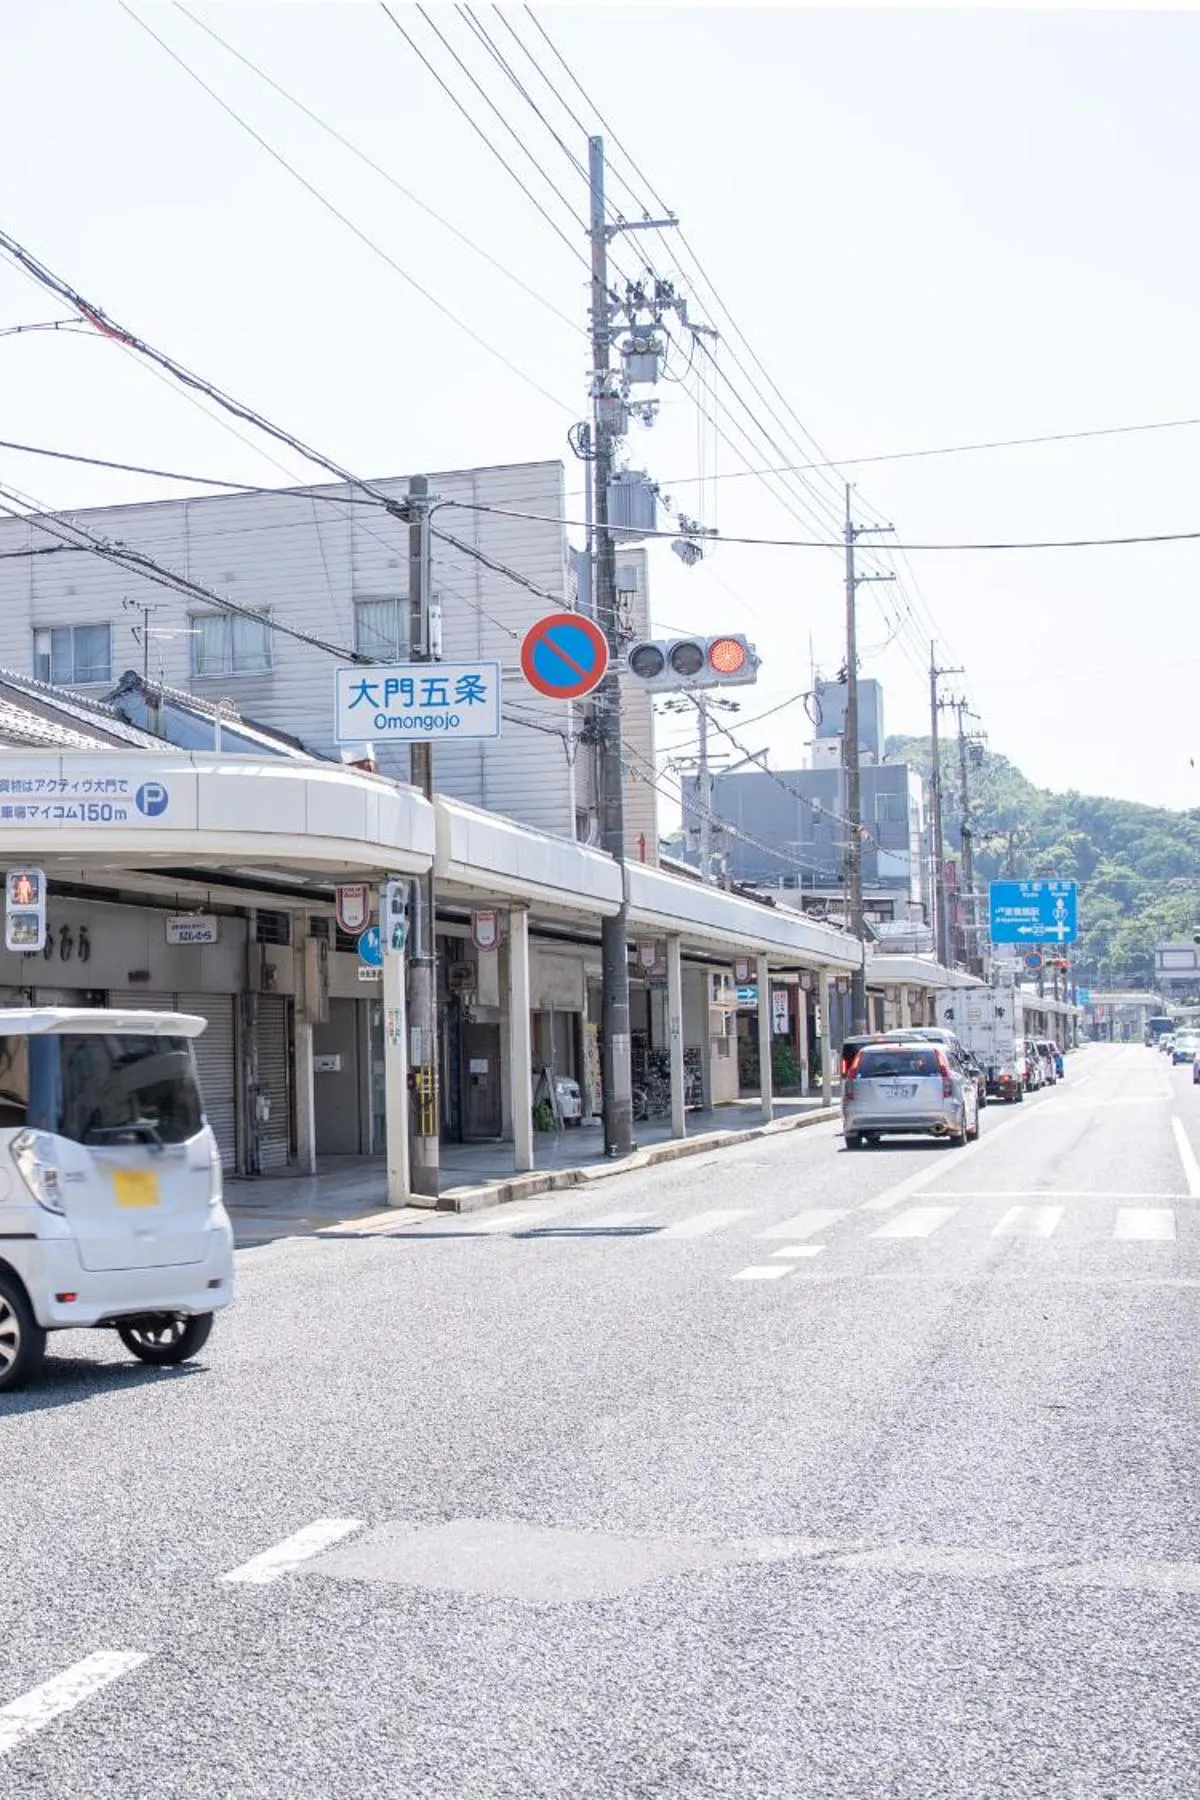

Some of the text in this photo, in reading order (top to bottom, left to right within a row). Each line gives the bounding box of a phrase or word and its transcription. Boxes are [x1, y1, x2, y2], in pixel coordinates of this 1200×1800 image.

[348, 674, 487, 709] 大門五条
[374, 712, 460, 730] Omongojo
[143, 785, 164, 815] P
